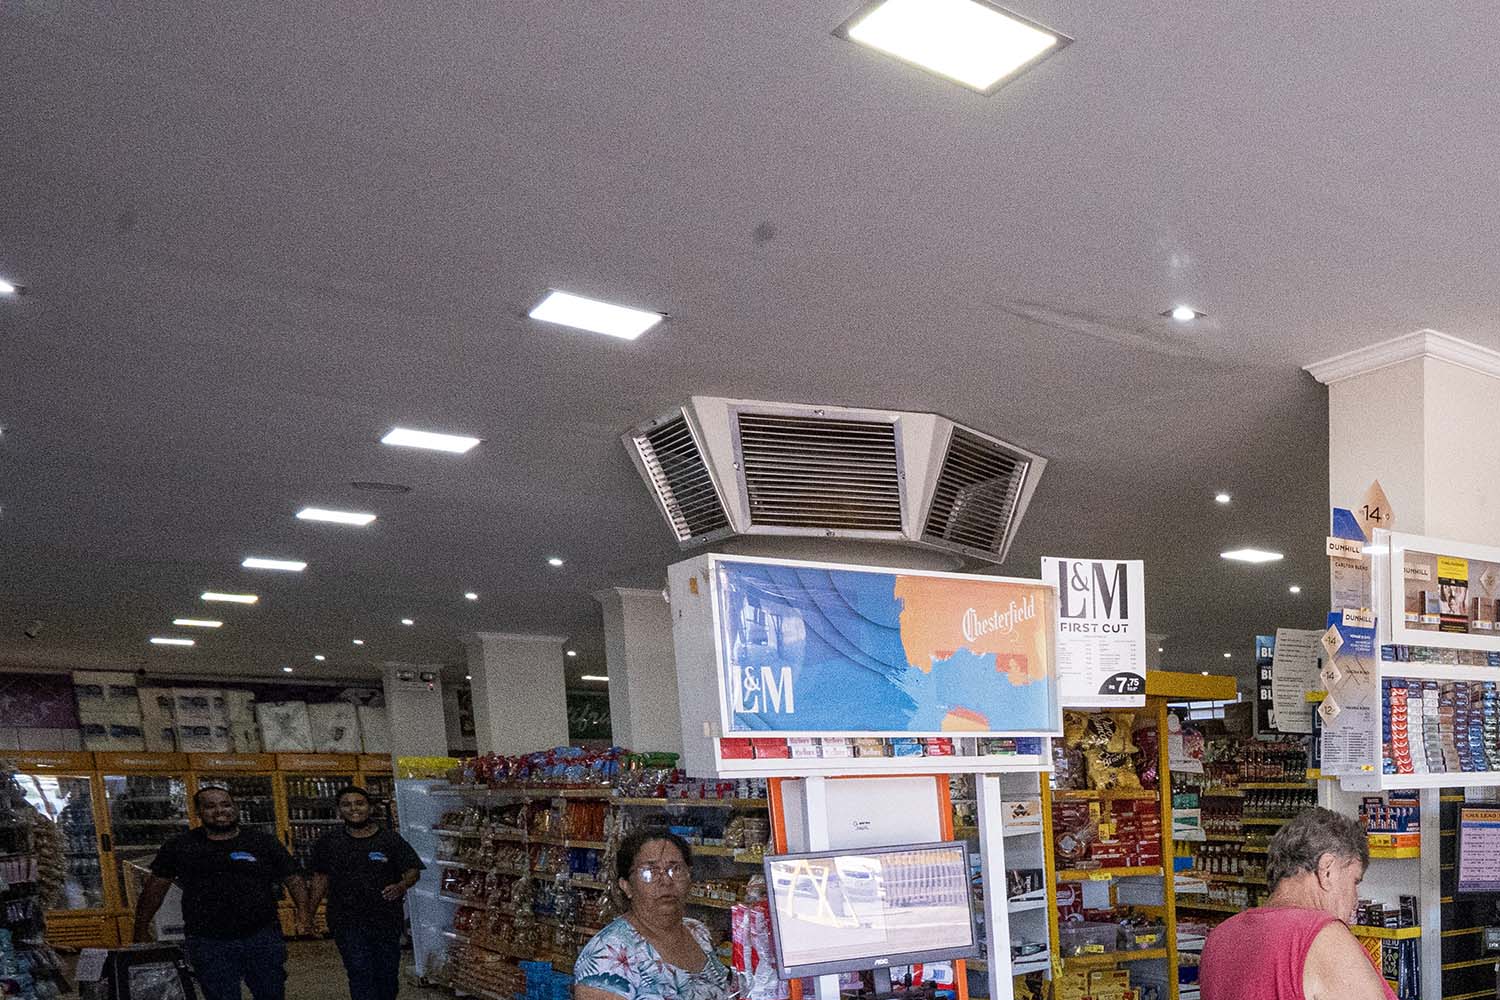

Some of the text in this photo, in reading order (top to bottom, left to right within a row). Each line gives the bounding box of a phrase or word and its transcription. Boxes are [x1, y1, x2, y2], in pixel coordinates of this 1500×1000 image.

[1329, 542, 1360, 554] DUNHILL
[1058, 560, 1128, 620] L&M
[962, 593, 1036, 642] Chesterfield
[1060, 622, 1128, 633] FIRST CUT
[1345, 614, 1372, 623] DUNHILL
[733, 665, 795, 714] L&M
